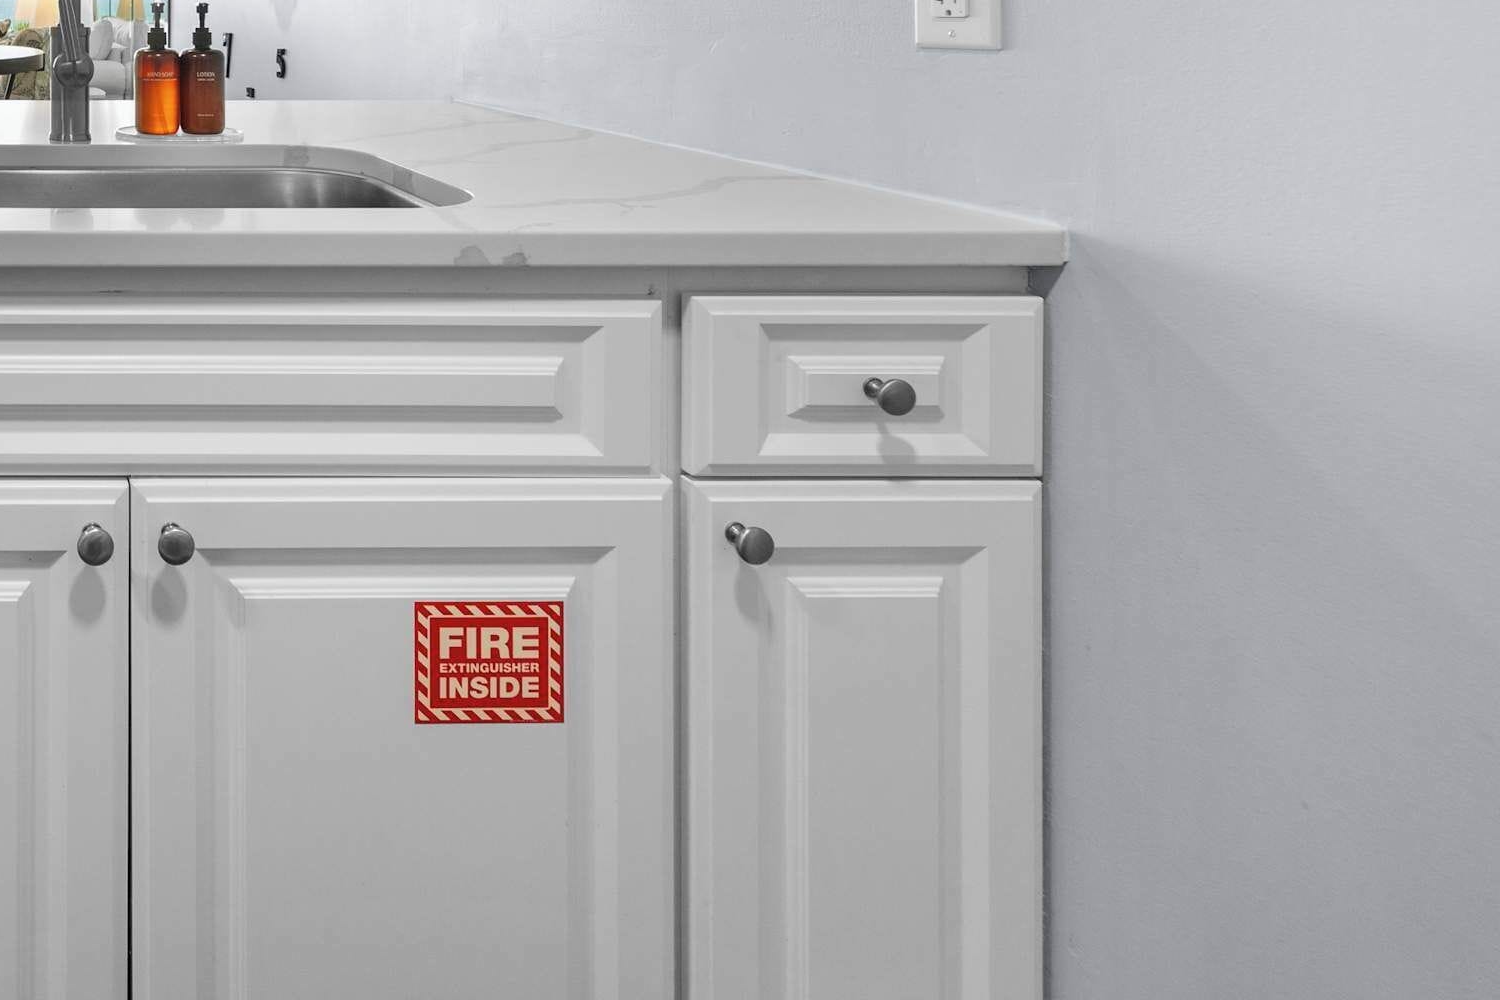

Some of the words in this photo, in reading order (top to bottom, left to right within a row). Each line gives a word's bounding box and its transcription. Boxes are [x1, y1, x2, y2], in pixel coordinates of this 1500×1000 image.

[276, 48, 287, 79] 5
[439, 626, 539, 659] FIRE
[439, 662, 539, 673] EXTINGUISHER
[439, 676, 539, 699] INSIDE
